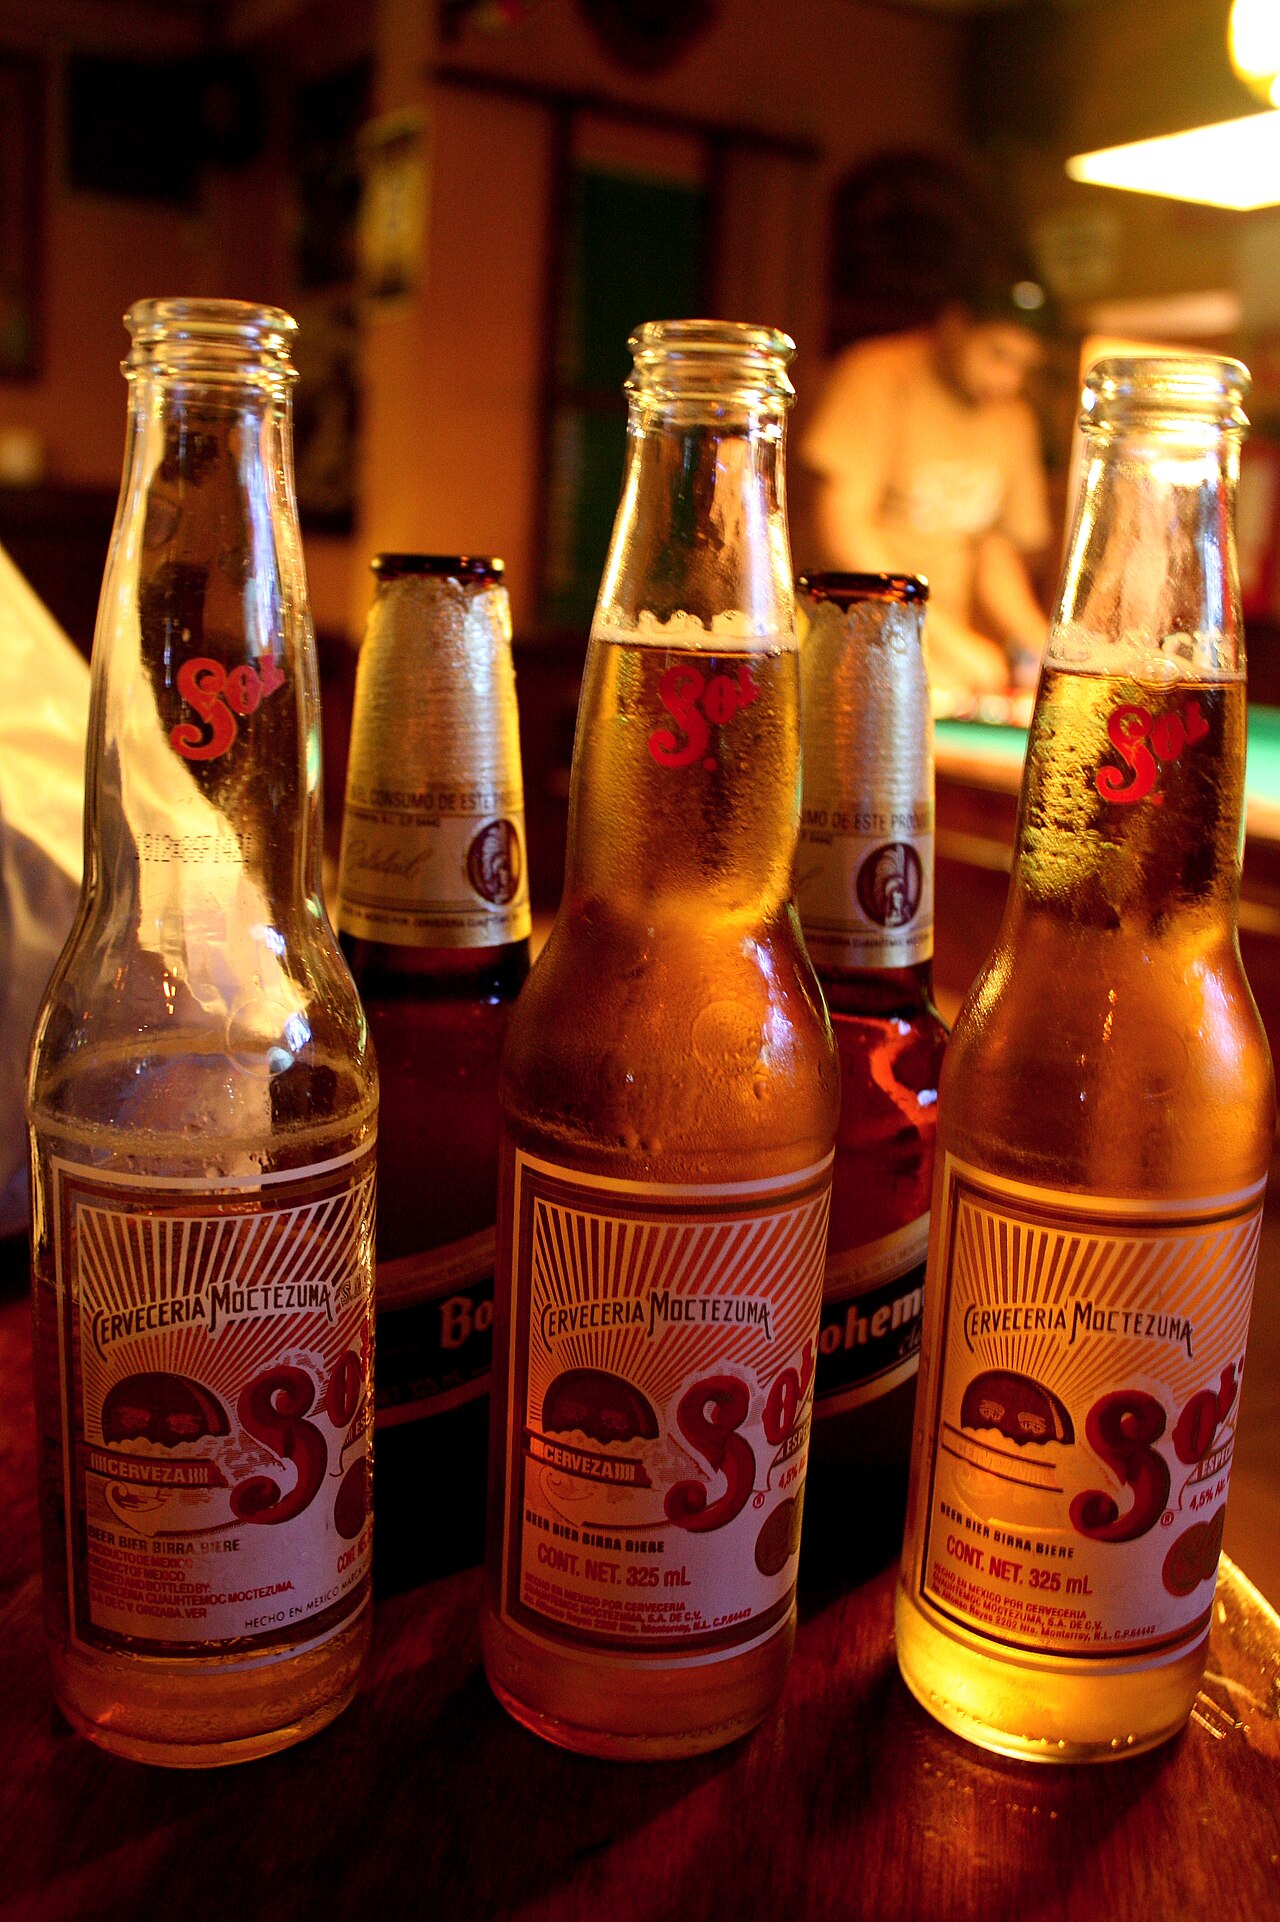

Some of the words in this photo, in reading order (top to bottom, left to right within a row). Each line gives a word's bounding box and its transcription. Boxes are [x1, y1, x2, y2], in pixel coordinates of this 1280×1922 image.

[170, 653, 286, 761] Sol
[92, 1296, 206, 1362] CERVECERIA
[208, 1281, 334, 1333] MOCTEZUMA
[541, 1300, 644, 1354] CERVECERIA
[646, 1291, 773, 1341] MOCTEZUMA
[820, 1287, 922, 1355] ohem
[964, 1303, 1067, 1353] CERVECERIA
[1069, 1301, 1194, 1358] MOCTEZUMA
[108, 1460, 185, 1482] CERVEZA
[545, 1444, 614, 1479] CERVEZA
[119, 1536, 147, 1551] BIER
[152, 1541, 194, 1554] BIRRA
[526, 1509, 550, 1531] BEER
[553, 1522, 579, 1542] BIER
[582, 1532, 622, 1550] BIRRA
[625, 1539, 664, 1553] BIERE
[941, 1501, 962, 1525] BEER
[965, 1517, 990, 1539] BIER
[994, 1530, 1031, 1552] BIRRA
[1036, 1542, 1074, 1559] BIERE
[538, 1542, 580, 1577] CONT.
[585, 1560, 621, 1584] NET.
[626, 1565, 659, 1587] 325
[664, 1566, 691, 1587] mL
[946, 1534, 984, 1572] CONT.
[989, 1557, 1023, 1585] NET.
[1029, 1567, 1060, 1592] 325
[1066, 1574, 1093, 1596] mL
[146, 1592, 226, 1606] CUAUHTEMOC
[245, 1611, 285, 1629] HECHO
[289, 1606, 303, 1618] EN
[306, 1587, 340, 1612] MEXICO
[624, 1602, 685, 1613] CERVECERIA
[670, 1612, 682, 1622] DE
[968, 1583, 1001, 1604] MEXICO
[1004, 1596, 1023, 1610] POR
[1025, 1603, 1087, 1619] CERVECERIA
[1070, 1620, 1082, 1630] DE
